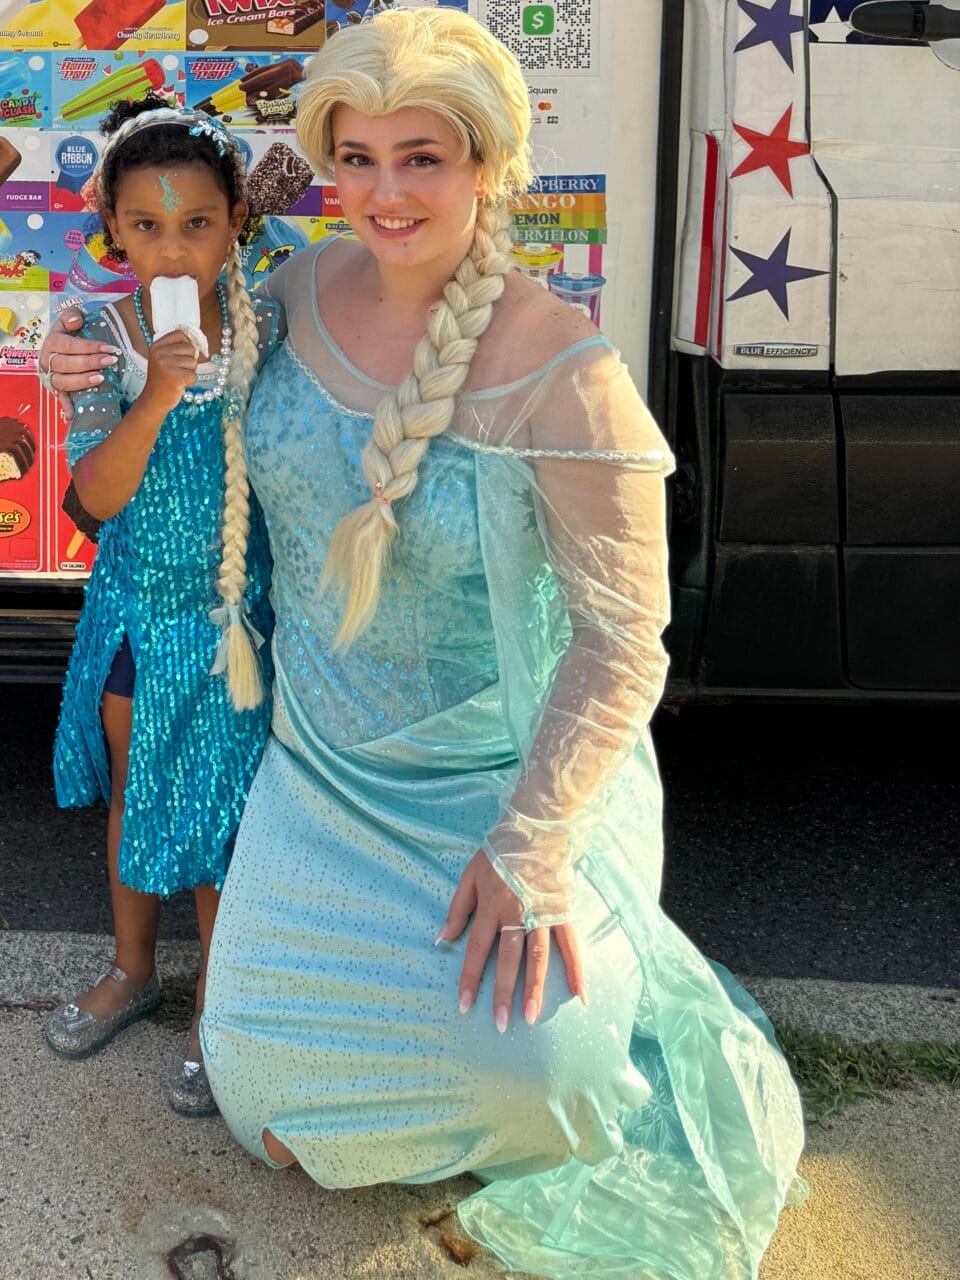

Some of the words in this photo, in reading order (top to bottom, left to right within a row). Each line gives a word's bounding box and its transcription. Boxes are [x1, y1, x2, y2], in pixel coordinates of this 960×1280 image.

[207, 18, 224, 26] Ice
[227, 11, 266, 24] Cream
[268, 8, 297, 19] Bars
[0, 96, 37, 109] CANDY
[3, 105, 35, 118] CLASH
[67, 145, 86, 153] BLUE
[61, 152, 93, 165] RIBBON
[740, 347, 762, 355] BLUE
[766, 347, 812, 356] EFFICIENCY
